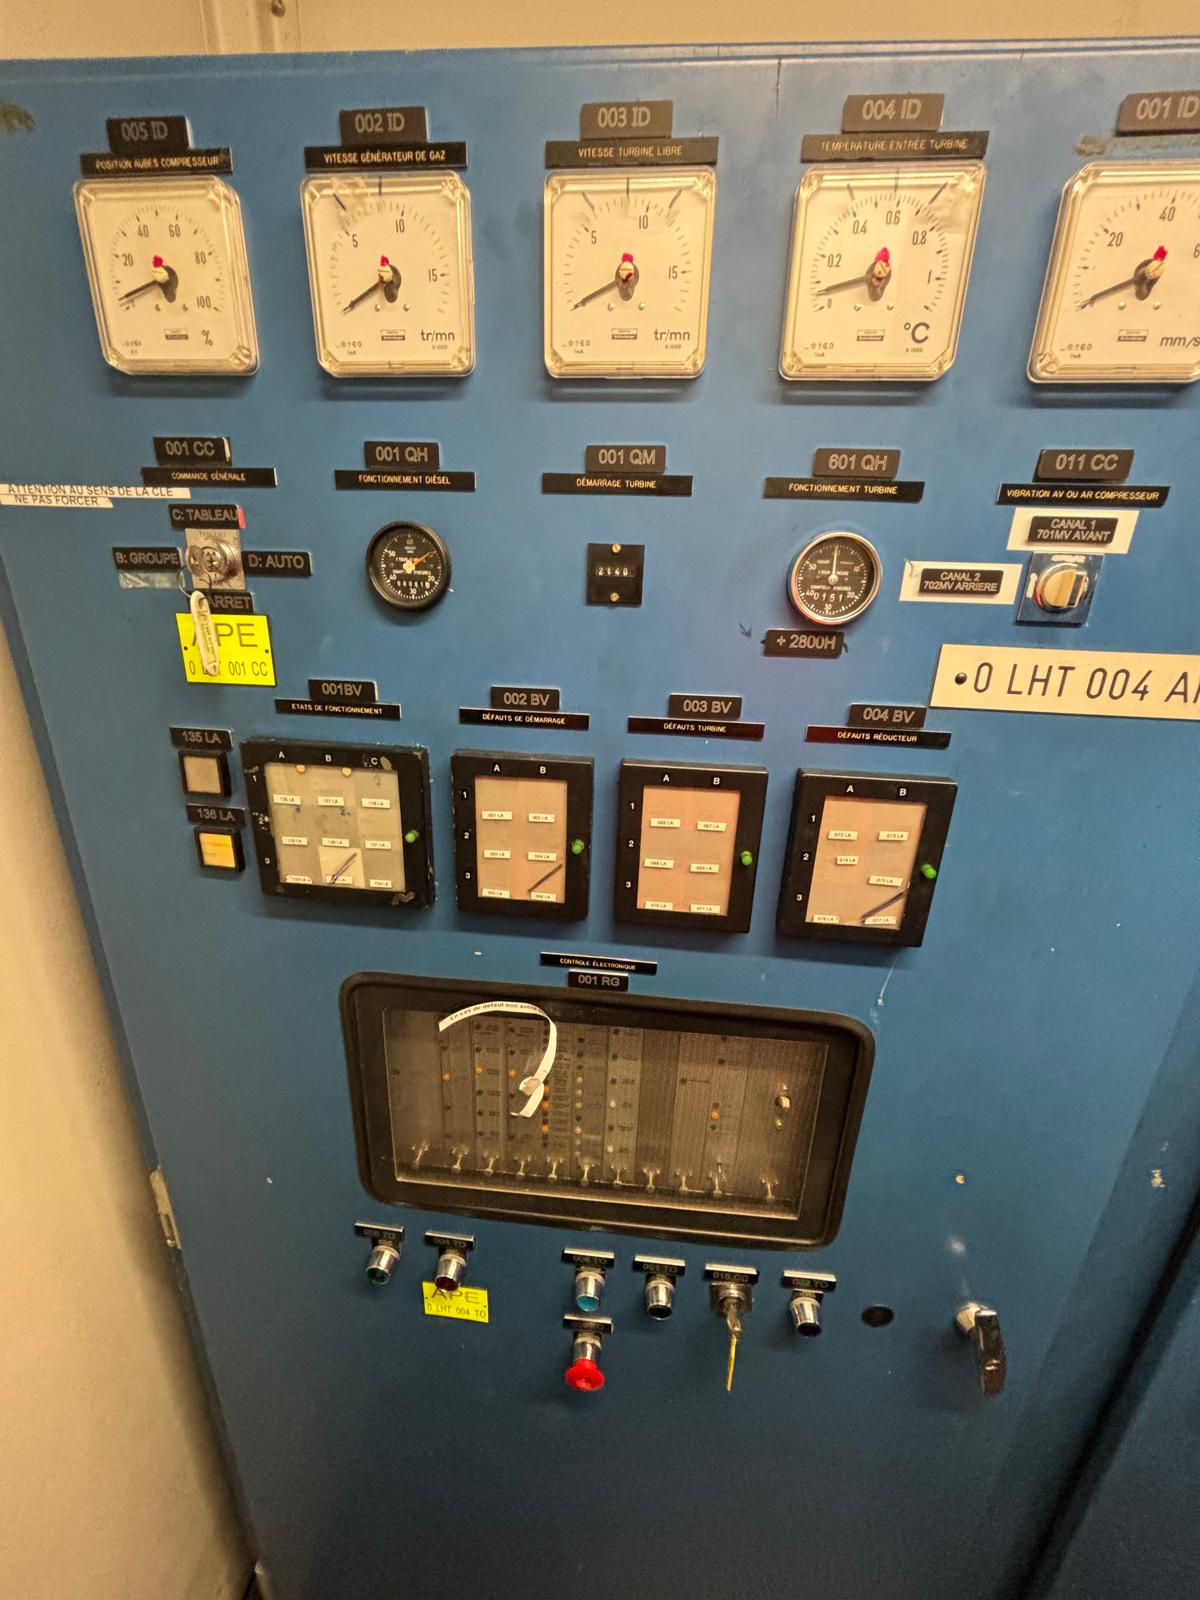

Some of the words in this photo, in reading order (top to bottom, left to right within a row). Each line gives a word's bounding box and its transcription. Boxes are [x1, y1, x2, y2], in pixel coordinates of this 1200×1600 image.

[862, 98, 896, 121] 004
[901, 98, 922, 120] ID
[1136, 97, 1171, 120] 001
[355, 114, 383, 133] 002
[387, 113, 405, 132] ID
[597, 106, 627, 128] 003
[631, 106, 651, 127] ID
[121, 122, 148, 141] 005
[152, 121, 169, 140] ID
[890, 138, 926, 150] ENTRÉE
[930, 138, 969, 149] TURBINE
[324, 152, 359, 164] VITESSE
[360, 149, 413, 163] GÉNÉRATEUR
[416, 150, 426, 161] DE
[429, 150, 446, 160] GAZ
[578, 148, 615, 158] VITESSE
[618, 146, 654, 157] TURBINE
[657, 145, 683, 156] LIBRE
[160, 156, 220, 168] COMPRESSEUR
[886, 210, 900, 225] 0.6
[1158, 206, 1176, 222] 40
[396, 219, 405, 233] 10
[639, 214, 649, 230] 10
[852, 220, 868, 235] 0.4
[138, 224, 150, 238] 40
[168, 224, 181, 238] 60
[591, 230, 597, 244] 5
[912, 230, 928, 245] 0.8
[352, 234, 358, 248] 5
[1107, 232, 1124, 248] 20
[122, 254, 134, 266] 20
[195, 251, 207, 265] 80
[827, 253, 842, 268] 0.2
[428, 268, 438, 282] 15
[668, 266, 678, 280] 15
[196, 296, 212, 309] 100
[202, 330, 213, 346] %
[420, 330, 455, 343] tr/mn
[654, 329, 690, 342] tr/mn
[904, 322, 930, 344] °C
[165, 441, 189, 456] 001
[193, 441, 215, 456] CC
[376, 446, 400, 461] 001
[405, 447, 428, 463] QH
[598, 449, 624, 464] 001
[630, 449, 656, 466] QM
[828, 454, 856, 470] 601
[861, 454, 888, 471] QH
[1055, 454, 1087, 471] 011
[1090, 454, 1119, 471] CC
[172, 472, 208, 480] COMMANDE
[211, 471, 246, 481] GÉNÉRALE
[358, 474, 422, 484] FONCTIONNEMENT
[576, 477, 622, 488] DÉMARRAGE
[625, 480, 657, 488] TURBINE
[8, 484, 67, 495] ATTENTION
[71, 486, 84, 495] AU
[87, 486, 116, 496] SENS
[118, 487, 132, 496] DE
[135, 488, 148, 496] LA
[152, 488, 174, 497] CLE
[789, 483, 862, 493] FONCTIONNEMENT
[864, 486, 898, 494] TURBINE
[1007, 489, 1050, 498] VIBRATION
[1052, 490, 1064, 498] AV
[1066, 490, 1079, 498] OU
[1080, 490, 1093, 498] AR
[1094, 491, 1160, 500] COMPRESSEUR
[15, 496, 29, 504] NE
[33, 496, 53, 504] PAS
[56, 496, 99, 506] FORCER
[172, 509, 184, 520] C:
[186, 509, 238, 521] TABLEAU
[1051, 518, 1087, 529] CANAL
[1090, 520, 1096, 529] 1
[1037, 529, 1072, 540] 701MV
[1072, 530, 1111, 541] AVANT
[115, 552, 128, 564] B:
[129, 552, 179, 564] GROUPE
[248, 556, 262, 568] D:
[266, 555, 304, 568] AUTO
[940, 571, 973, 581] CANAL
[974, 572, 980, 582] 2
[923, 580, 955, 590] 702MV
[956, 581, 998, 592] ARRIERE
[789, 634, 836, 650] 2800H
[229, 661, 246, 676] 001
[252, 662, 268, 676] CC
[322, 682, 362, 696] 001BV
[1006, 664, 1076, 697] LHT
[1086, 667, 1152, 701] 004
[504, 692, 527, 705] 002
[530, 694, 550, 706] BV
[325, 705, 383, 714] FONCTIONNEMENT
[683, 700, 708, 712] 003
[711, 701, 732, 714] BV
[482, 713, 512, 721] DÉFAUTS
[525, 715, 566, 725] DÉMARRAGE
[863, 707, 889, 721] 004
[892, 710, 916, 723] BV
[663, 722, 695, 731] DÉFAUTS
[698, 725, 727, 733] TURBINE
[182, 730, 203, 743] 135
[205, 732, 222, 744] LA
[837, 731, 871, 740] DÉFAUTS
[873, 732, 918, 742] RÉDUCTEUR
[278, 751, 285, 759] A
[494, 764, 500, 772] A
[540, 766, 546, 774] B
[663, 774, 670, 782] A
[714, 777, 720, 785] B
[846, 785, 854, 793] A
[899, 788, 907, 796] B
[219, 810, 235, 821] LA
[592, 961, 636, 970] ÉLECTRONIQUE
[578, 974, 598, 985] 001
[601, 976, 620, 987] RG
[436, 1305, 452, 1314] LHT
[456, 1306, 470, 1316] 004
[475, 1310, 486, 1318] TO
